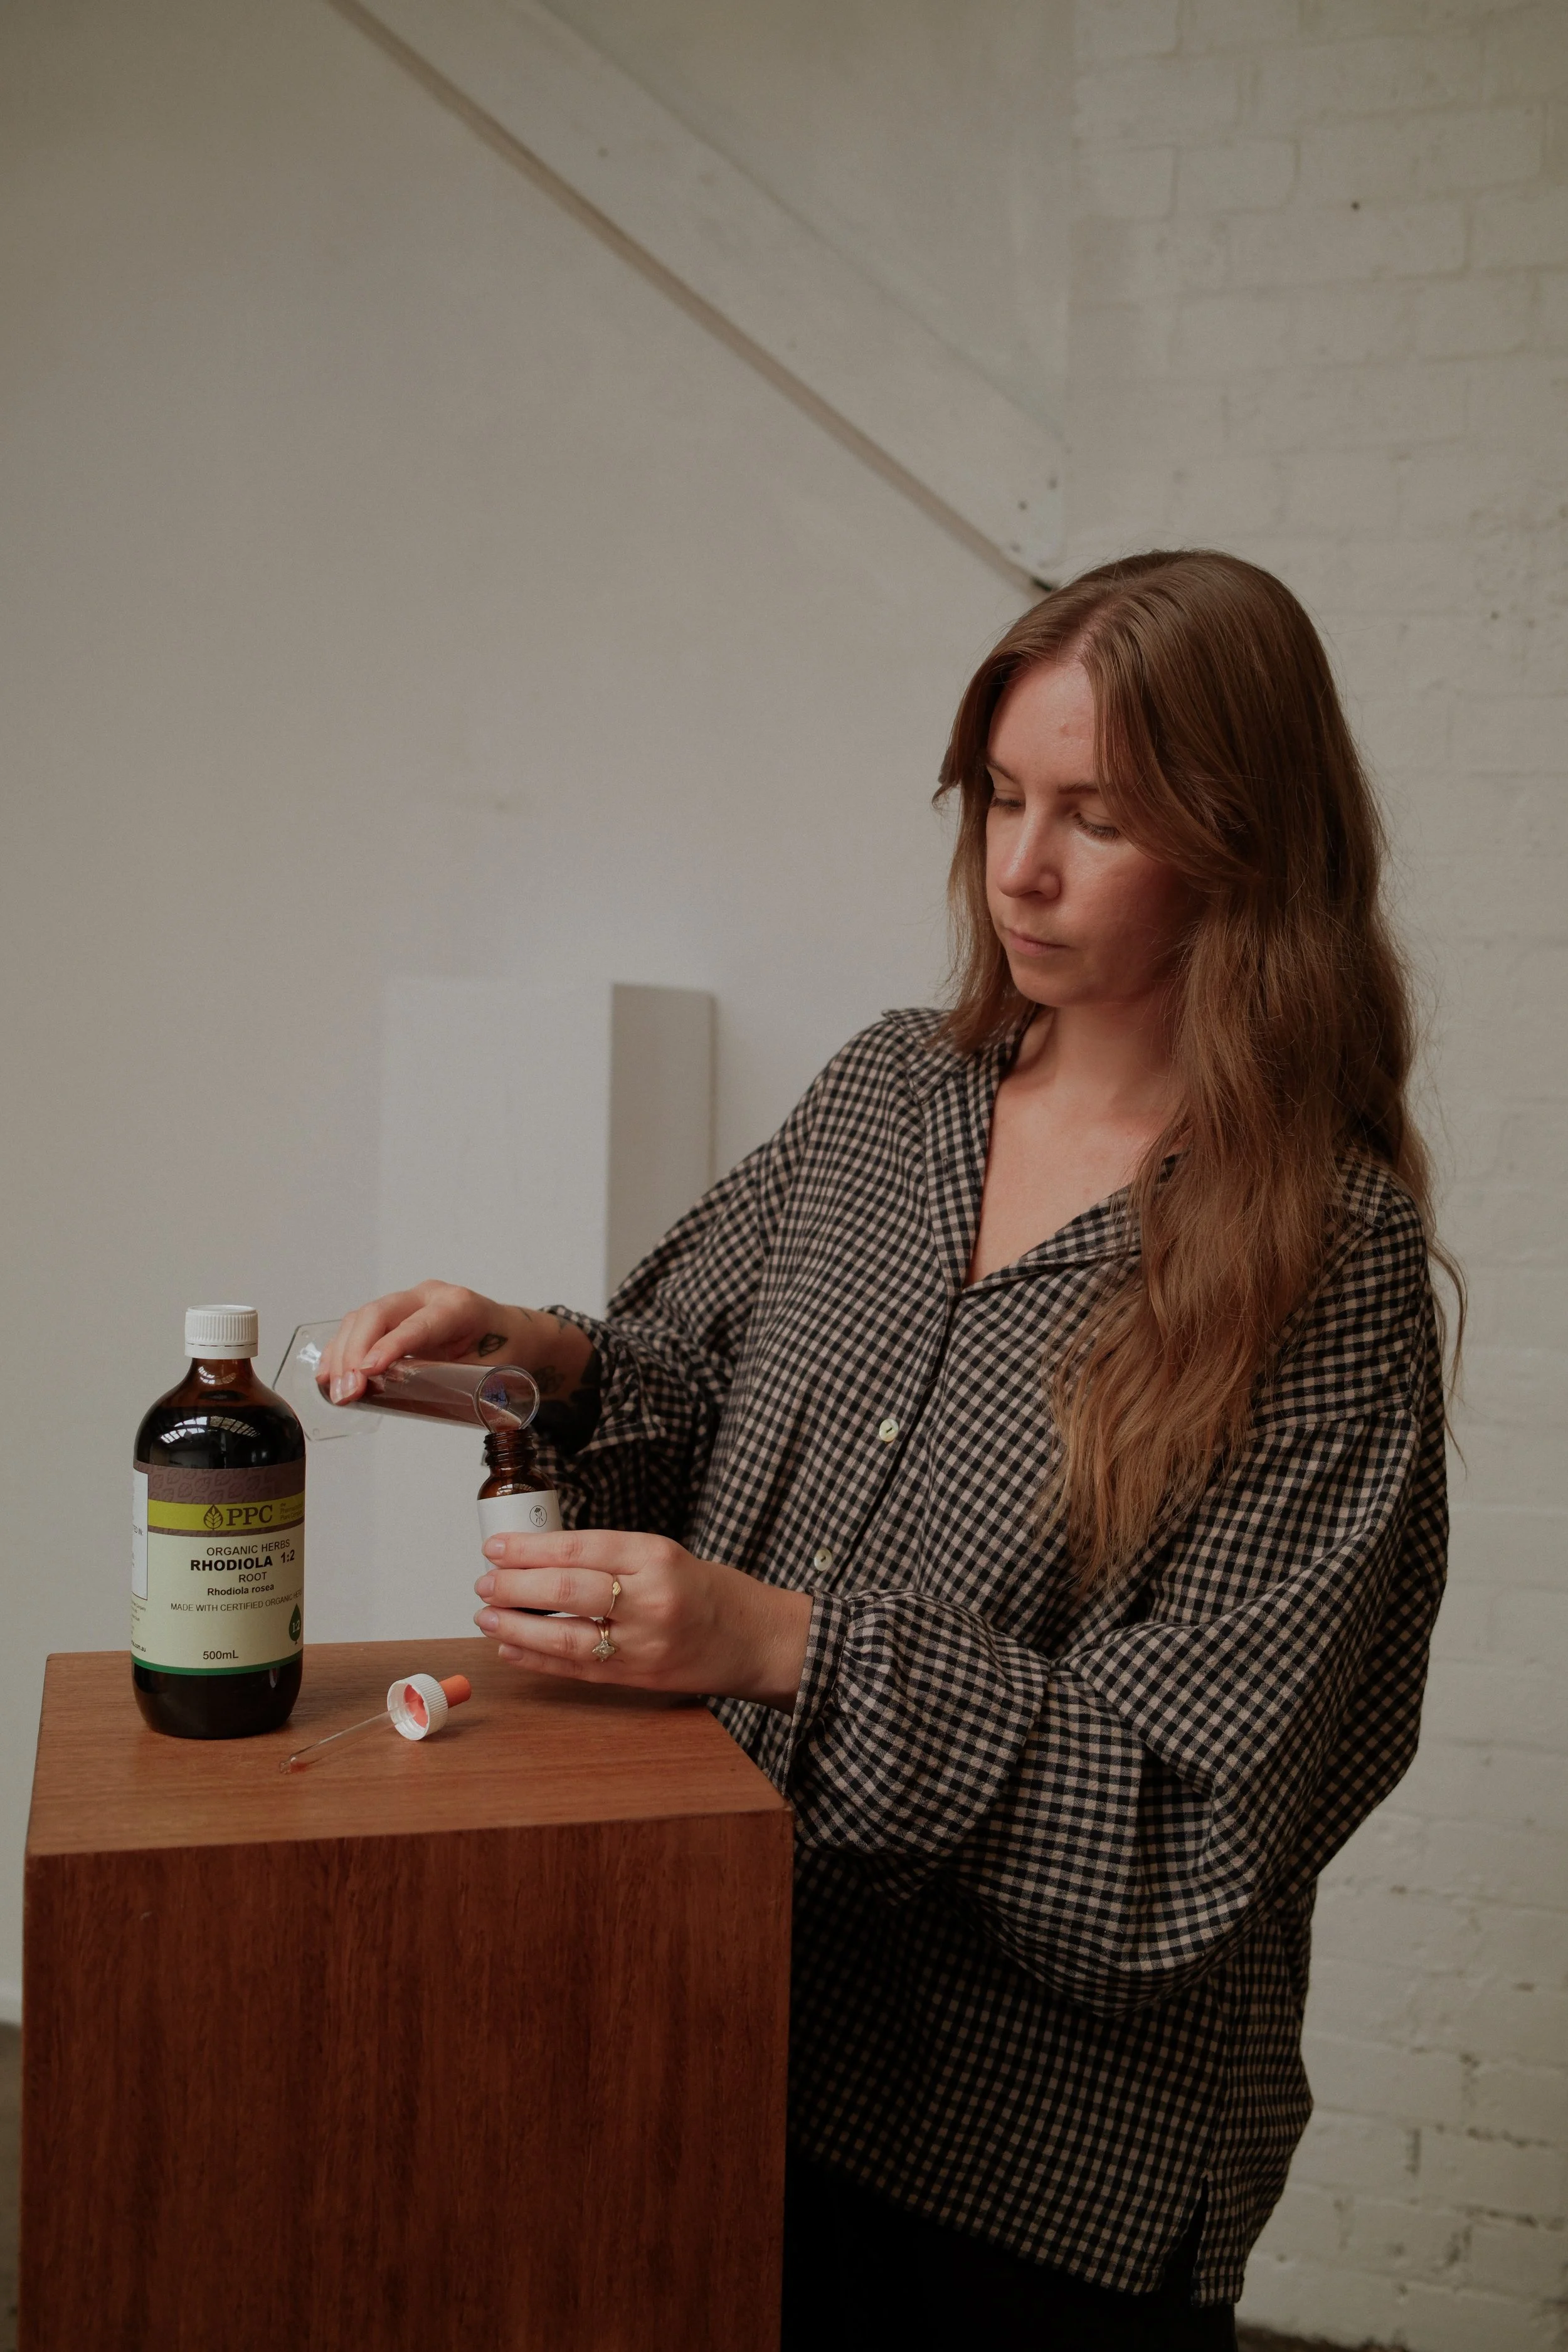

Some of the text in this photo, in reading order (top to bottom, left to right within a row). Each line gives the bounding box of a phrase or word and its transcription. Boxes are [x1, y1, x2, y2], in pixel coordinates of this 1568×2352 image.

[226, 1505, 273, 1526] PPC
[206, 1539, 290, 1556] ORGANIC HERBS
[190, 1549, 295, 1571] RHODIOLA 1:2
[238, 1571, 267, 1583] ROOT
[207, 1584, 274, 1596] Rhodiola rosea
[171, 1602, 193, 1611] MADE
[220, 1601, 263, 1611] CERTIFIED
[265, 1593, 293, 1607] ORGANIC
[292, 1619, 300, 1633] 1:2
[203, 1650, 239, 1660] 500mL
